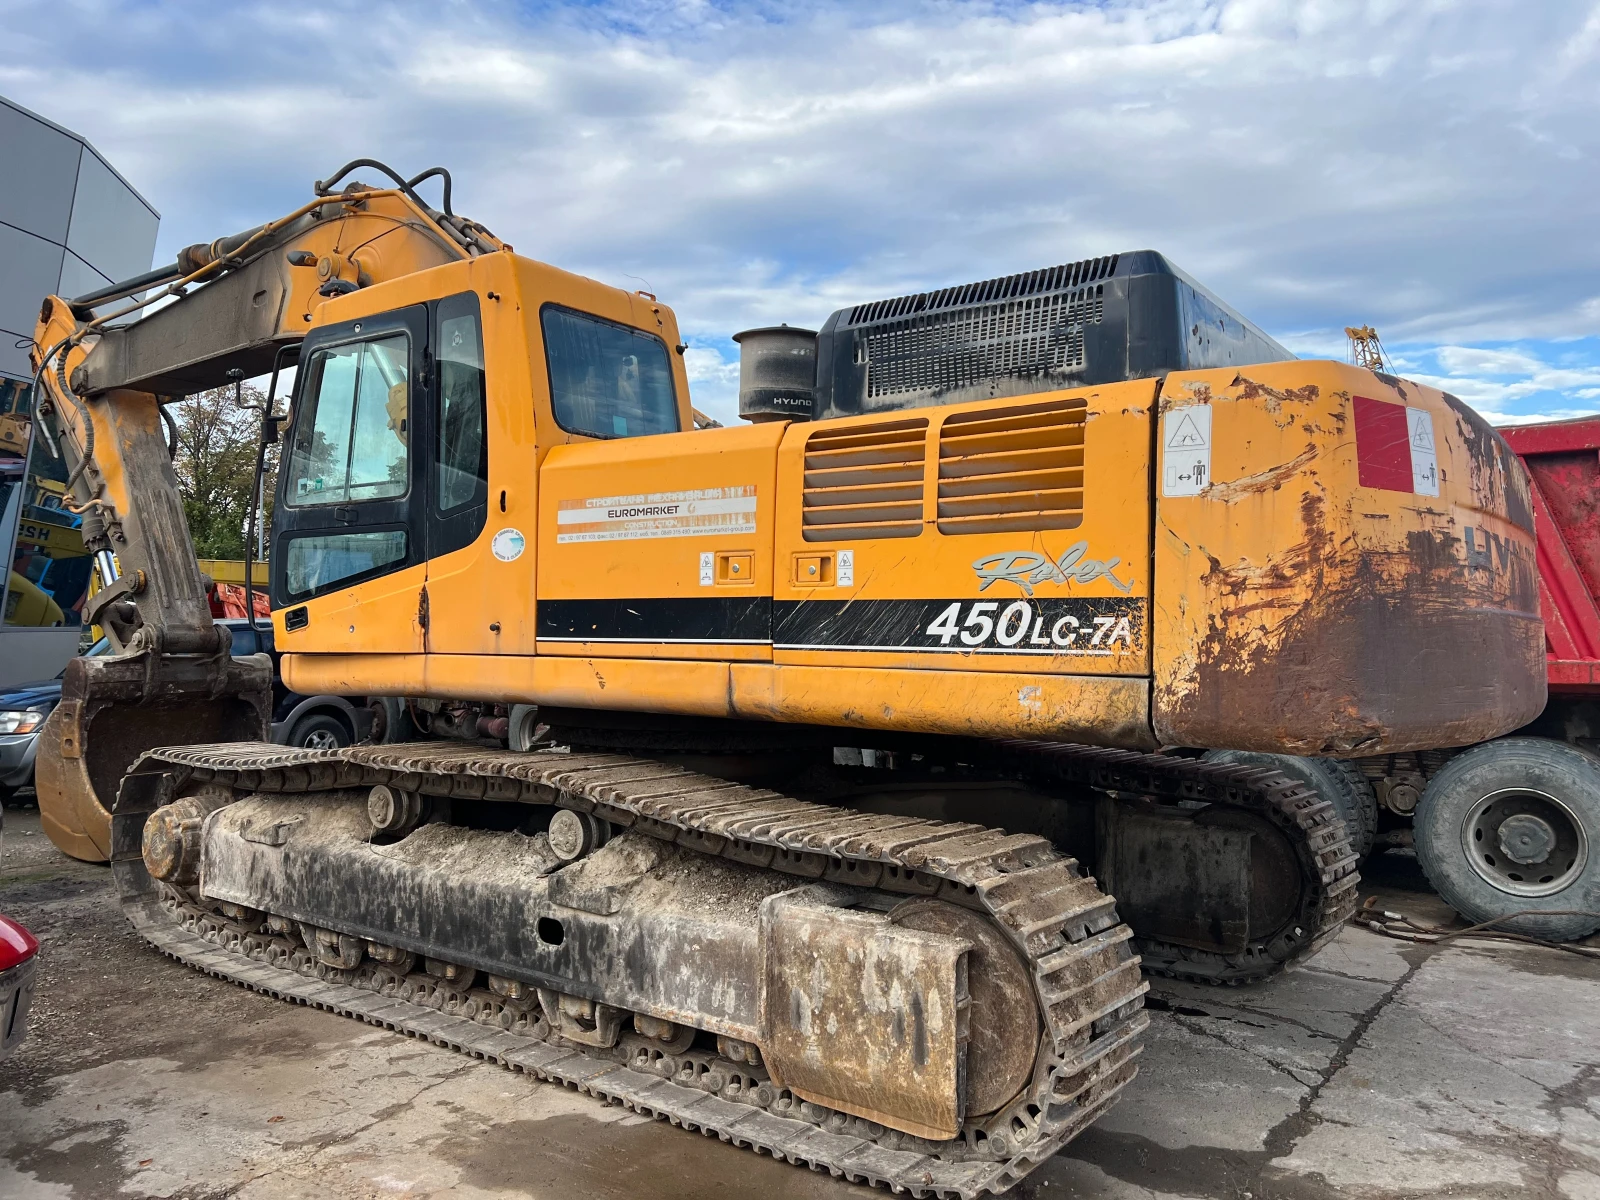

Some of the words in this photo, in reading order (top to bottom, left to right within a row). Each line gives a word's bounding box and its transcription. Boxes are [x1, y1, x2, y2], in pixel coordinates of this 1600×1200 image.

[773, 397, 812, 407] HYUND
[607, 505, 680, 518] EUROMARKET
[972, 540, 1135, 596] Robex
